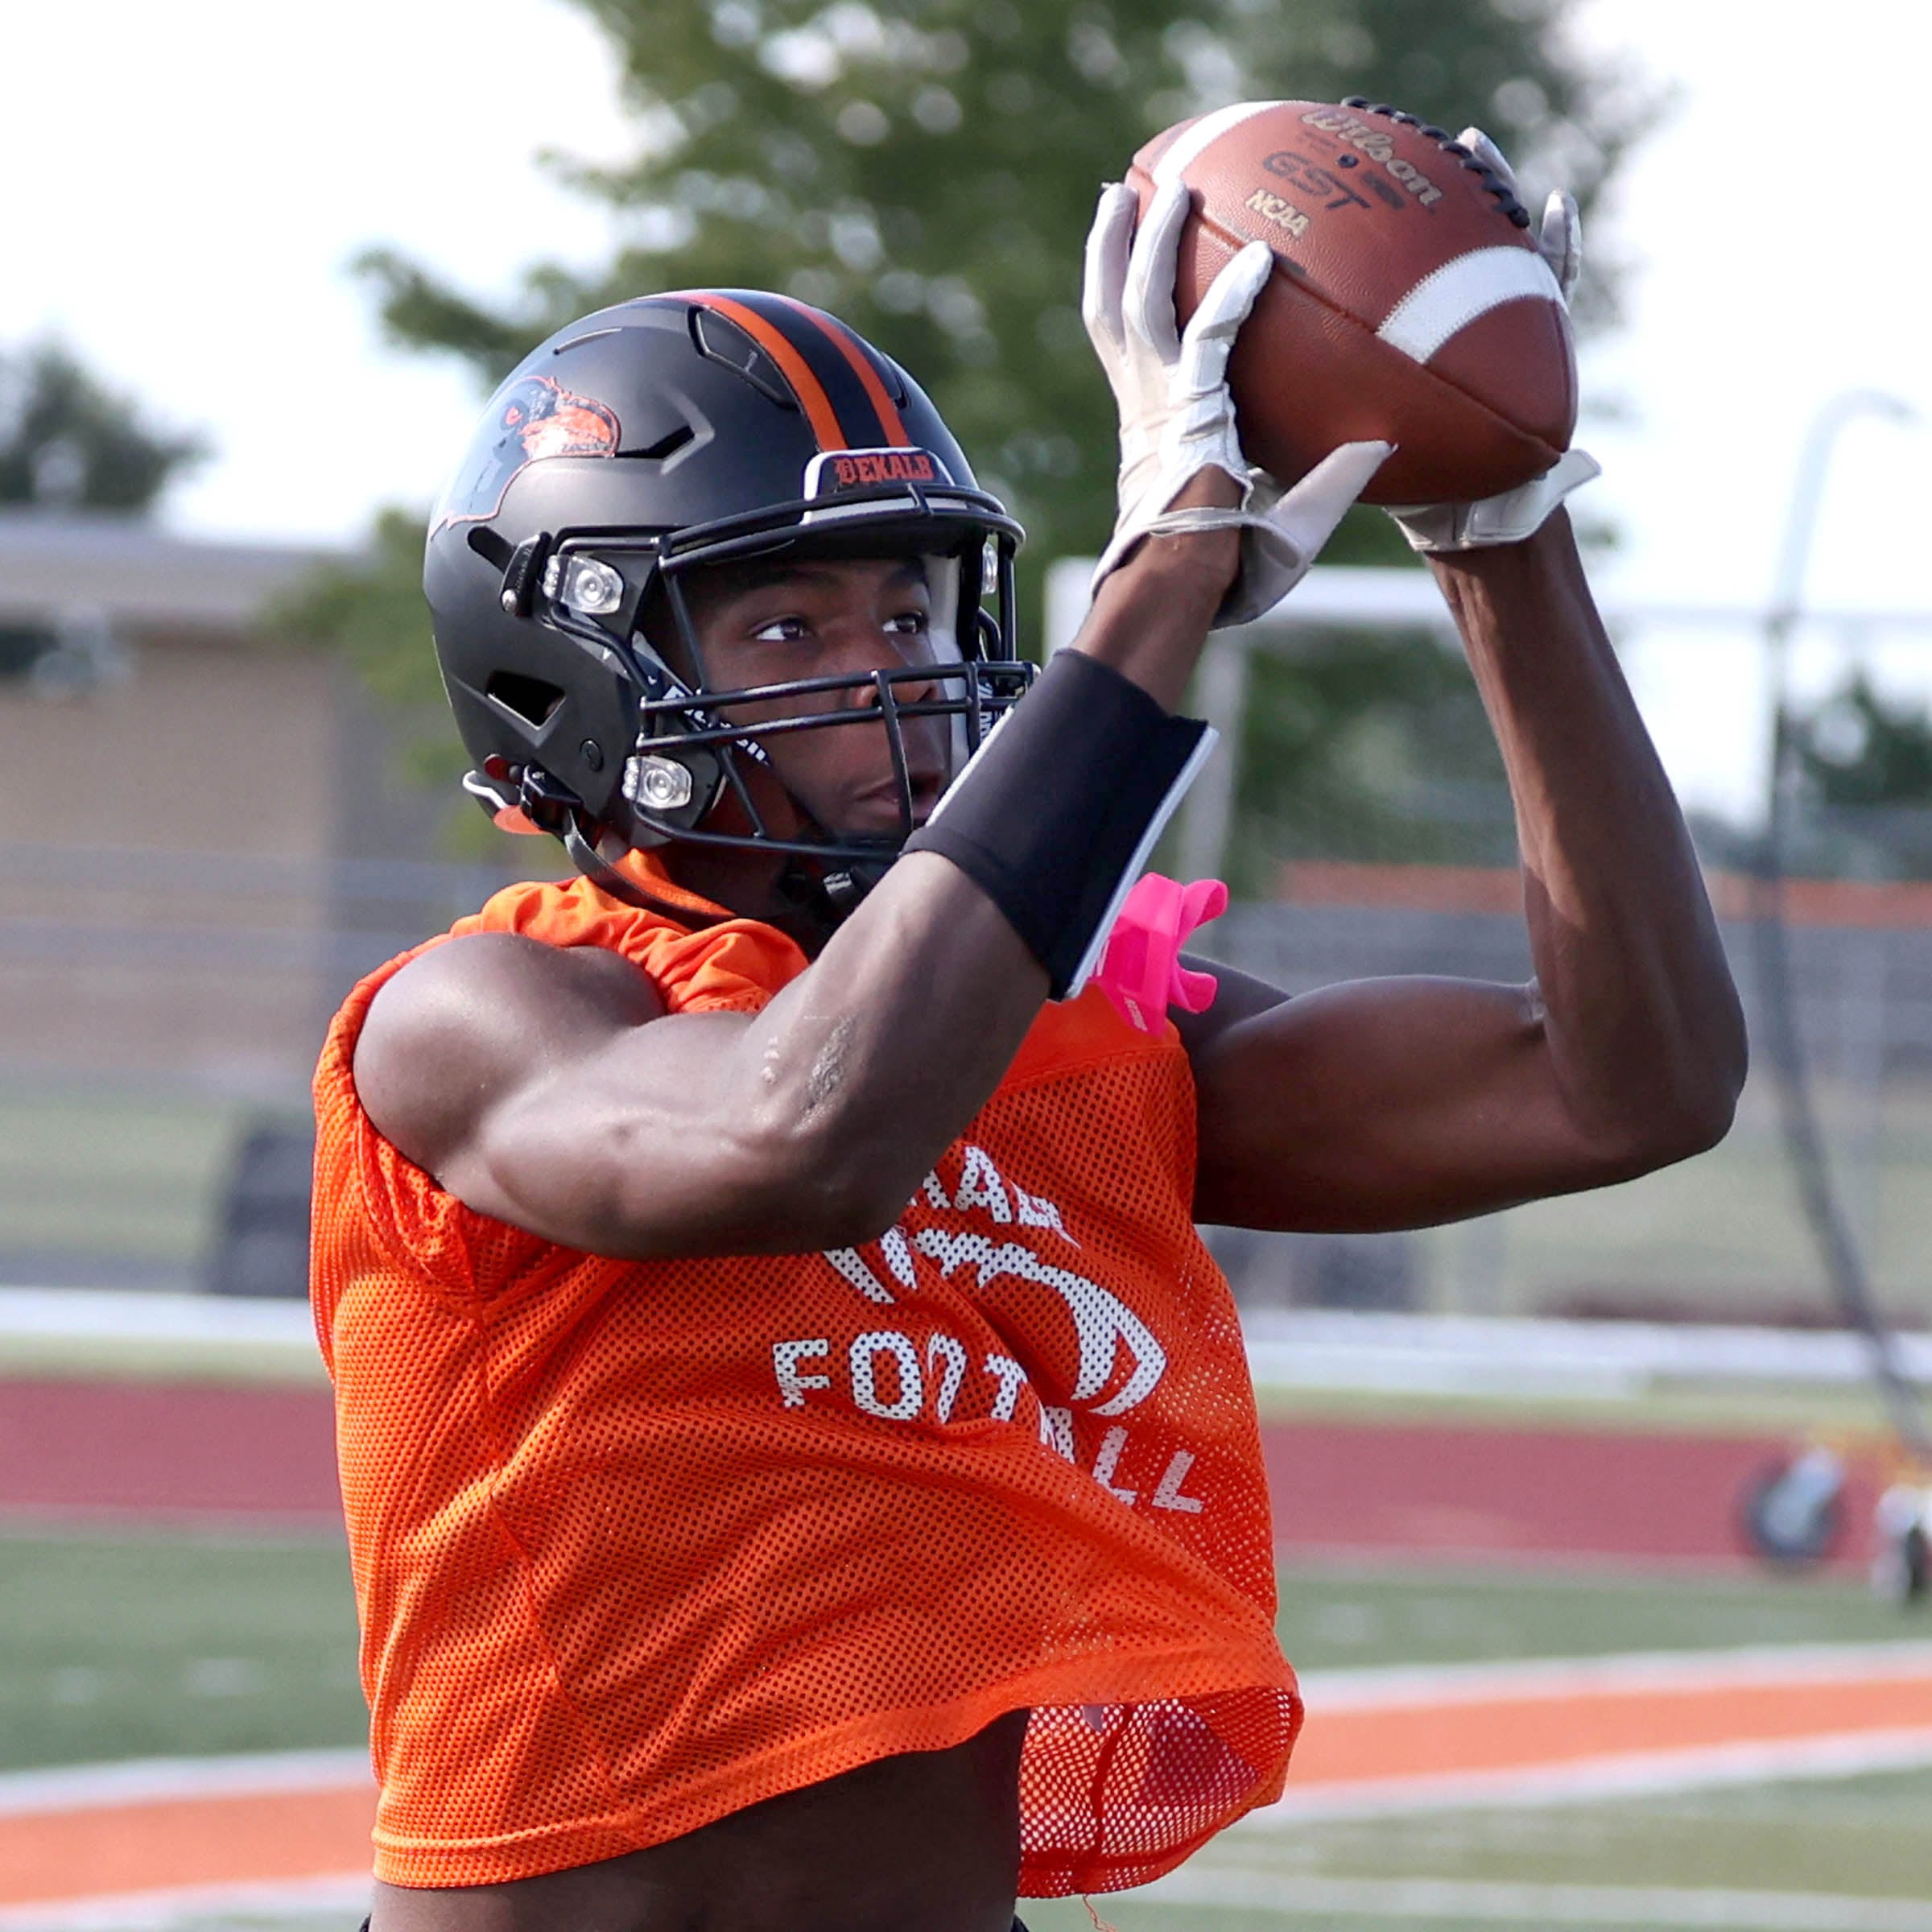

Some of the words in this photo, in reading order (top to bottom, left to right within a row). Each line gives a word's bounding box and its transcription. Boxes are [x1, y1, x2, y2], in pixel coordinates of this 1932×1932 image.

[1263, 151, 1371, 209] GST
[1300, 108, 1443, 207] Wilson
[1245, 189, 1310, 237] NCAA
[835, 455, 935, 484] DEKALB
